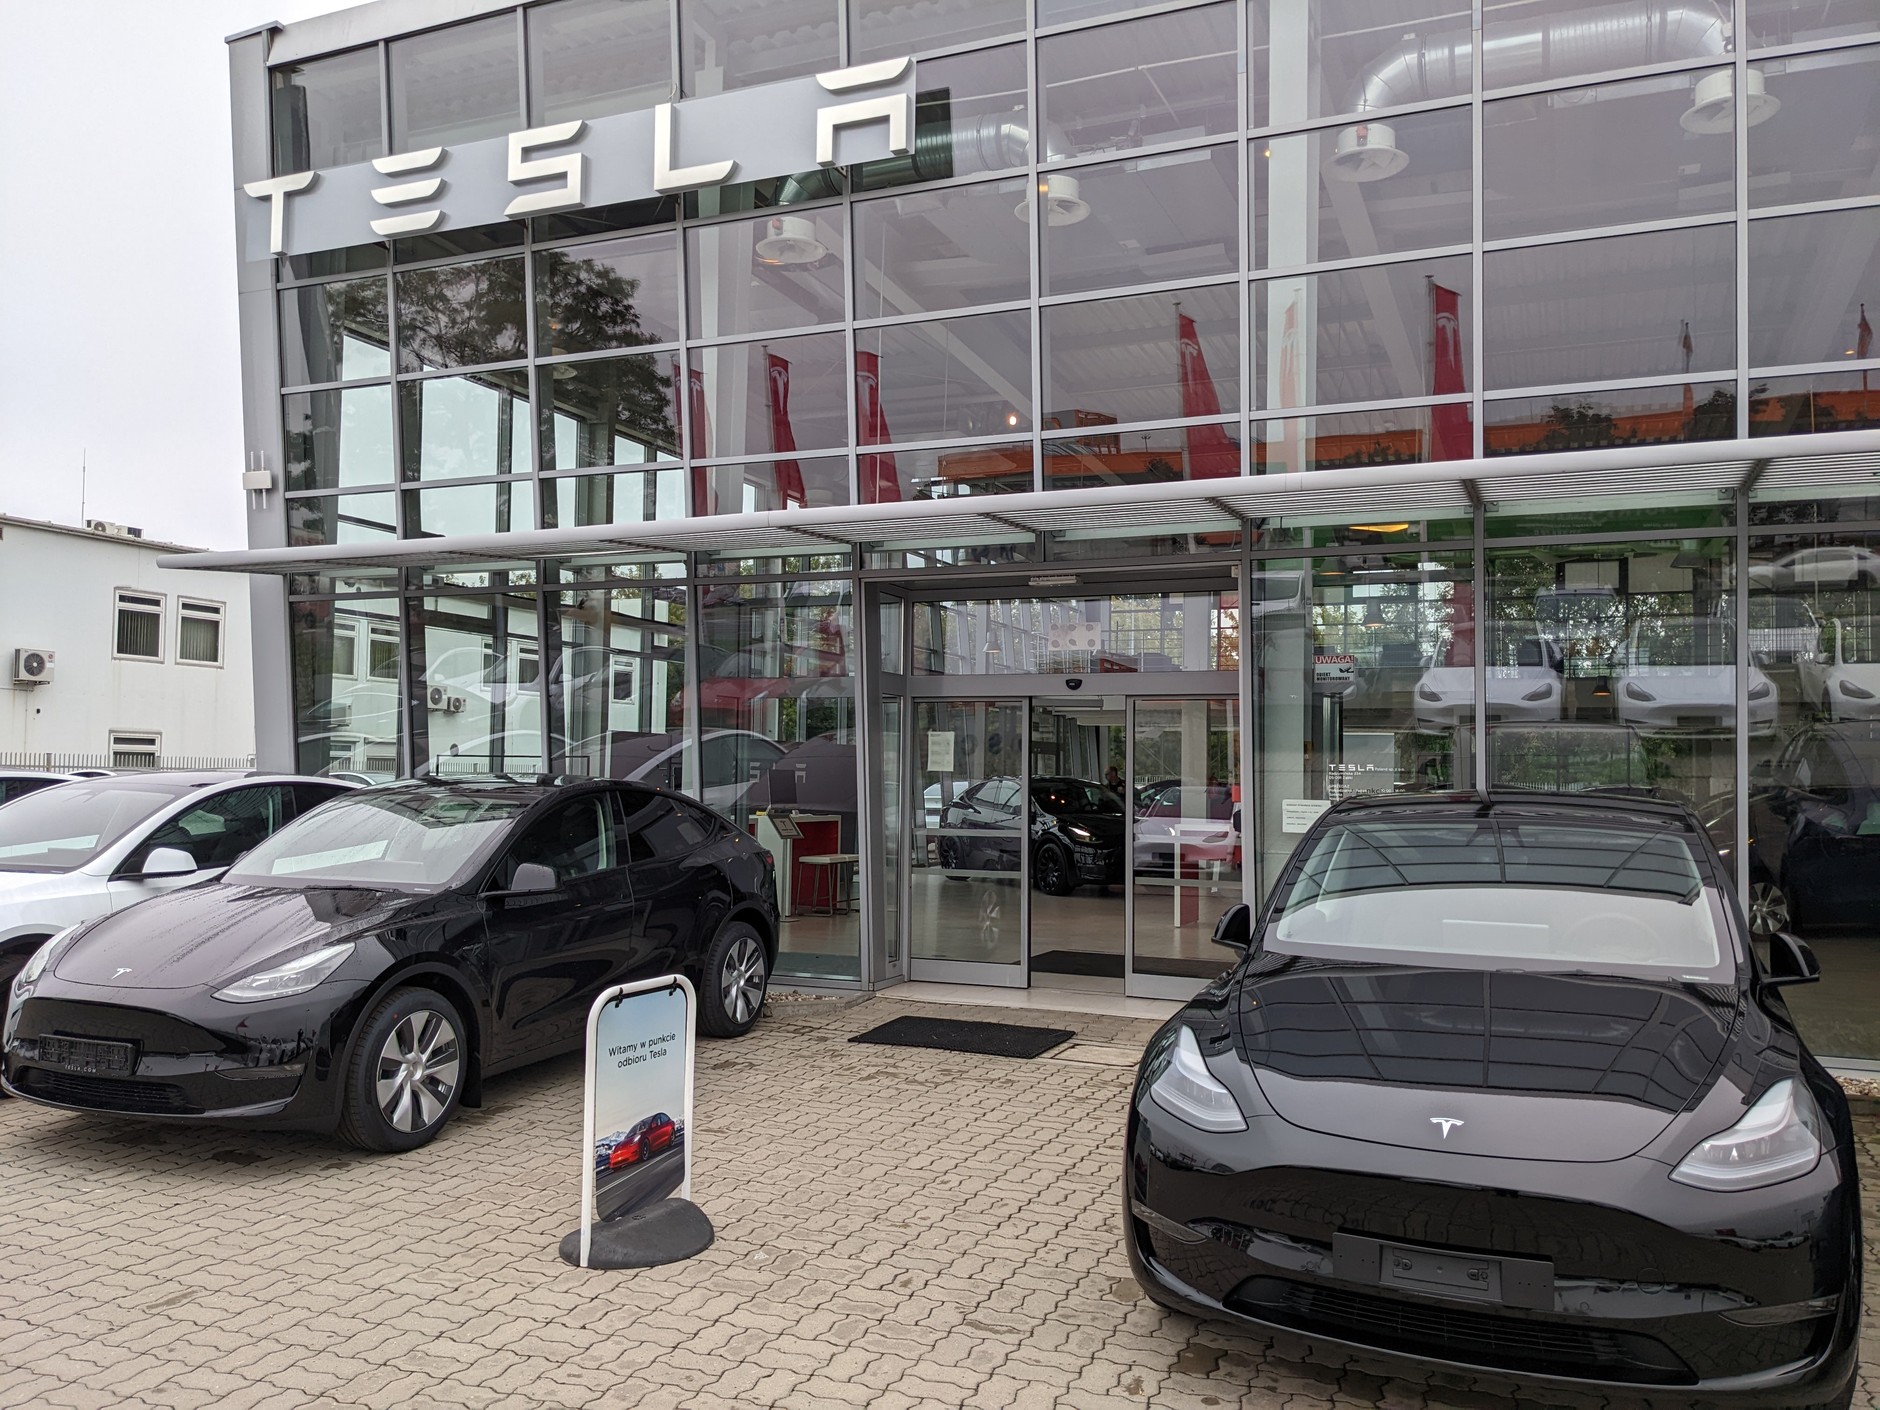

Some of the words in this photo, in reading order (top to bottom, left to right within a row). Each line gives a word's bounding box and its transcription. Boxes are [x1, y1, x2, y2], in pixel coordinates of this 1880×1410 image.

[243, 56, 915, 257] TESLA
[1315, 655, 1354, 664] UWAGA!
[1328, 763, 1375, 772] TESLA
[608, 1042, 638, 1057] Witamy
[639, 1041, 647, 1049] w
[648, 1032, 676, 1048] punkcie
[617, 1054, 647, 1068] odbioru
[649, 1047, 667, 1060] Tesla
